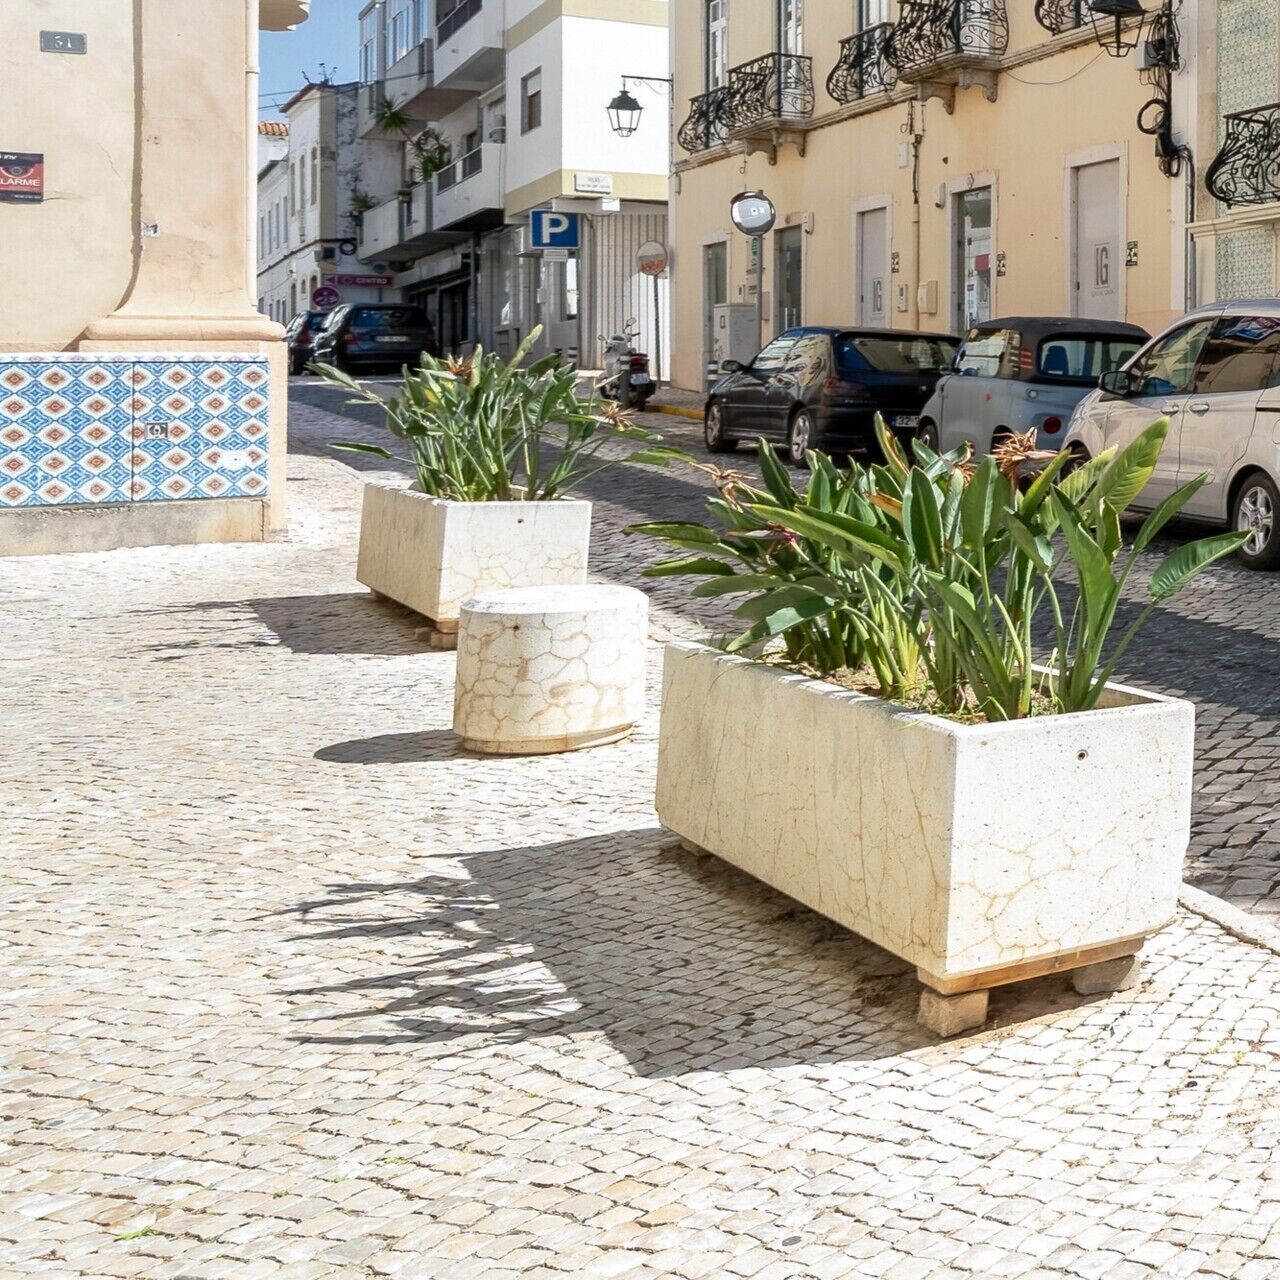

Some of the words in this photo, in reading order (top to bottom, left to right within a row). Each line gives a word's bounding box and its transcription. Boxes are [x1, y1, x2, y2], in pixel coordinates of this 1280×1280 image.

[0, 177, 40, 187] LARME
[542, 213, 569, 244] P
[1096, 246, 1109, 286] IG
